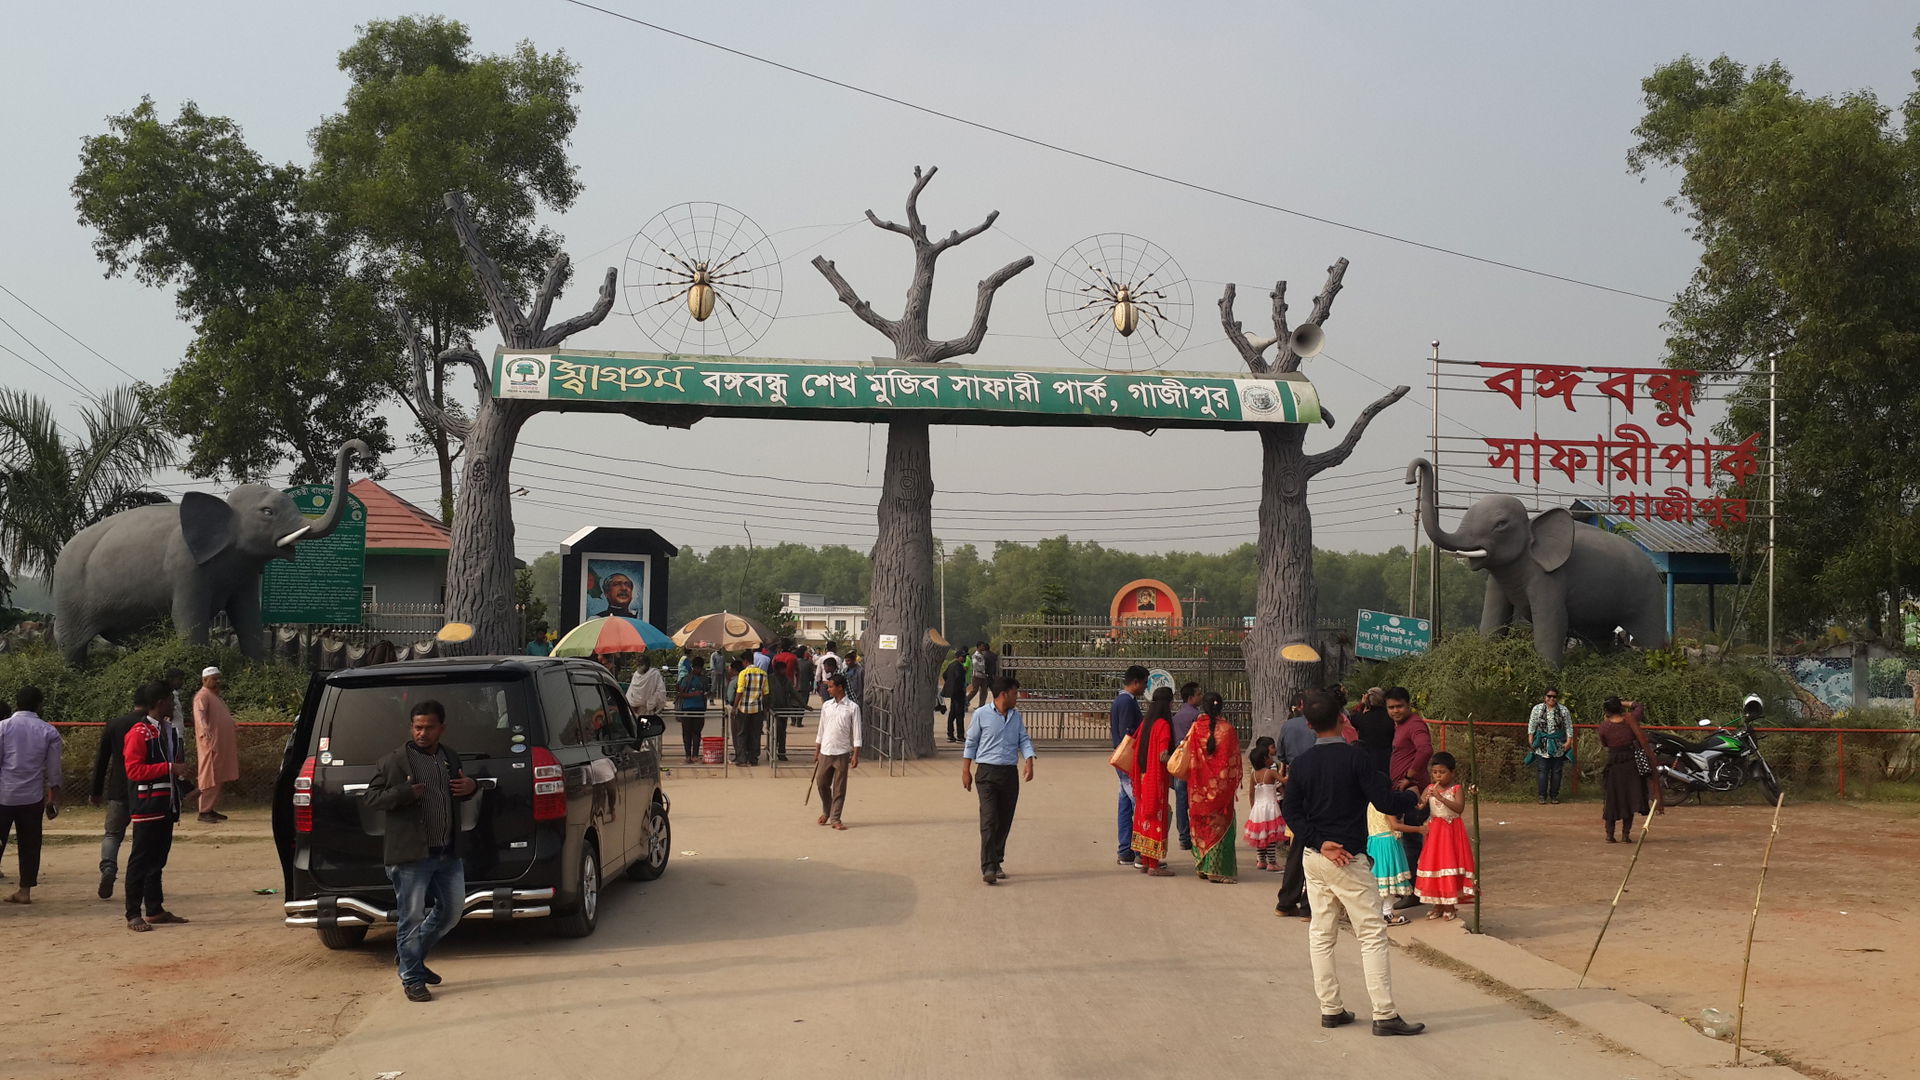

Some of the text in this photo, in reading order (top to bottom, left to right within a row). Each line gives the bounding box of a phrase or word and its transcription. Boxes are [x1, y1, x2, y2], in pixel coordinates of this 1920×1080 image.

[700, 371, 790, 406] বঙ্গবন্ধু
[802, 372, 858, 398] শেখ
[865, 368, 941, 406] মুজিব
[950, 373, 1041, 404] সাফারী
[1052, 376, 1119, 412] পার্ক,
[1128, 378, 1230, 416] গাজীপুর
[1613, 487, 1750, 531] গাজীপুর
